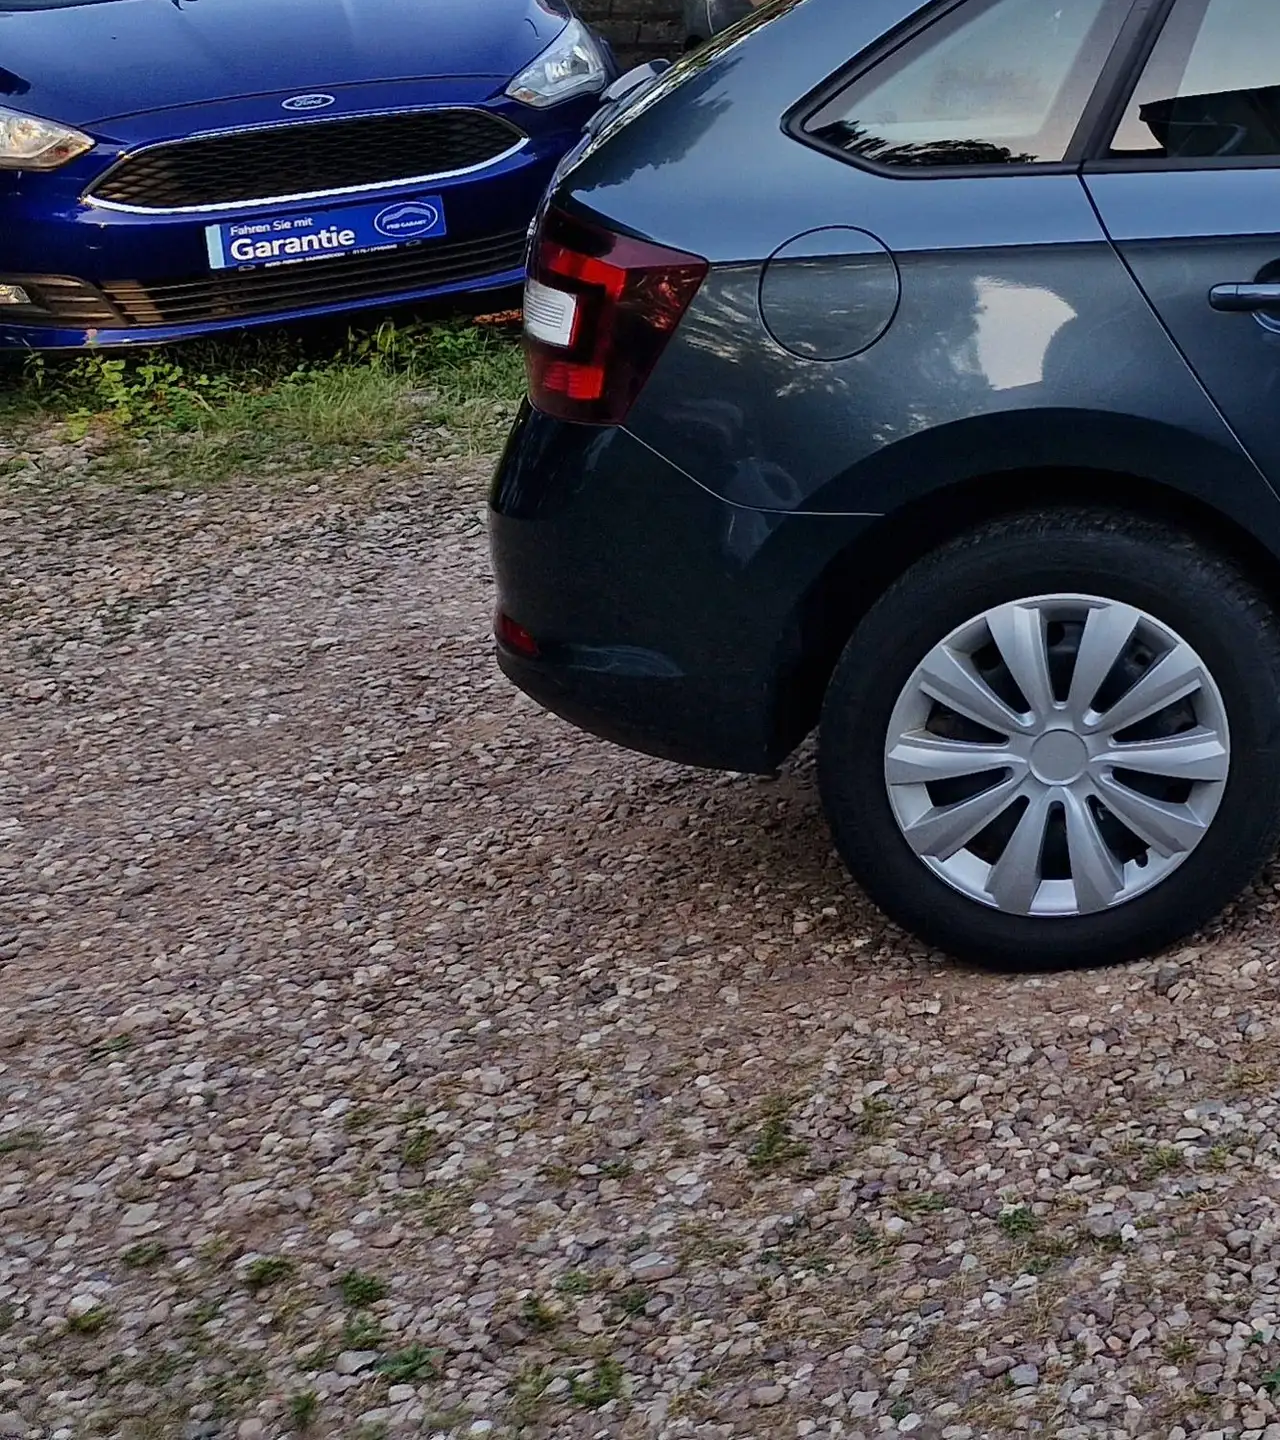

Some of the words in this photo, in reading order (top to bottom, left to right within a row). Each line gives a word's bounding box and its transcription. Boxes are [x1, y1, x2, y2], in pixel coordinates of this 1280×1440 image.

[293, 95, 323, 107] Ford
[230, 223, 271, 236] Fahren
[273, 219, 292, 231] Sie
[294, 217, 314, 228] mit
[230, 226, 356, 260] Garantie
